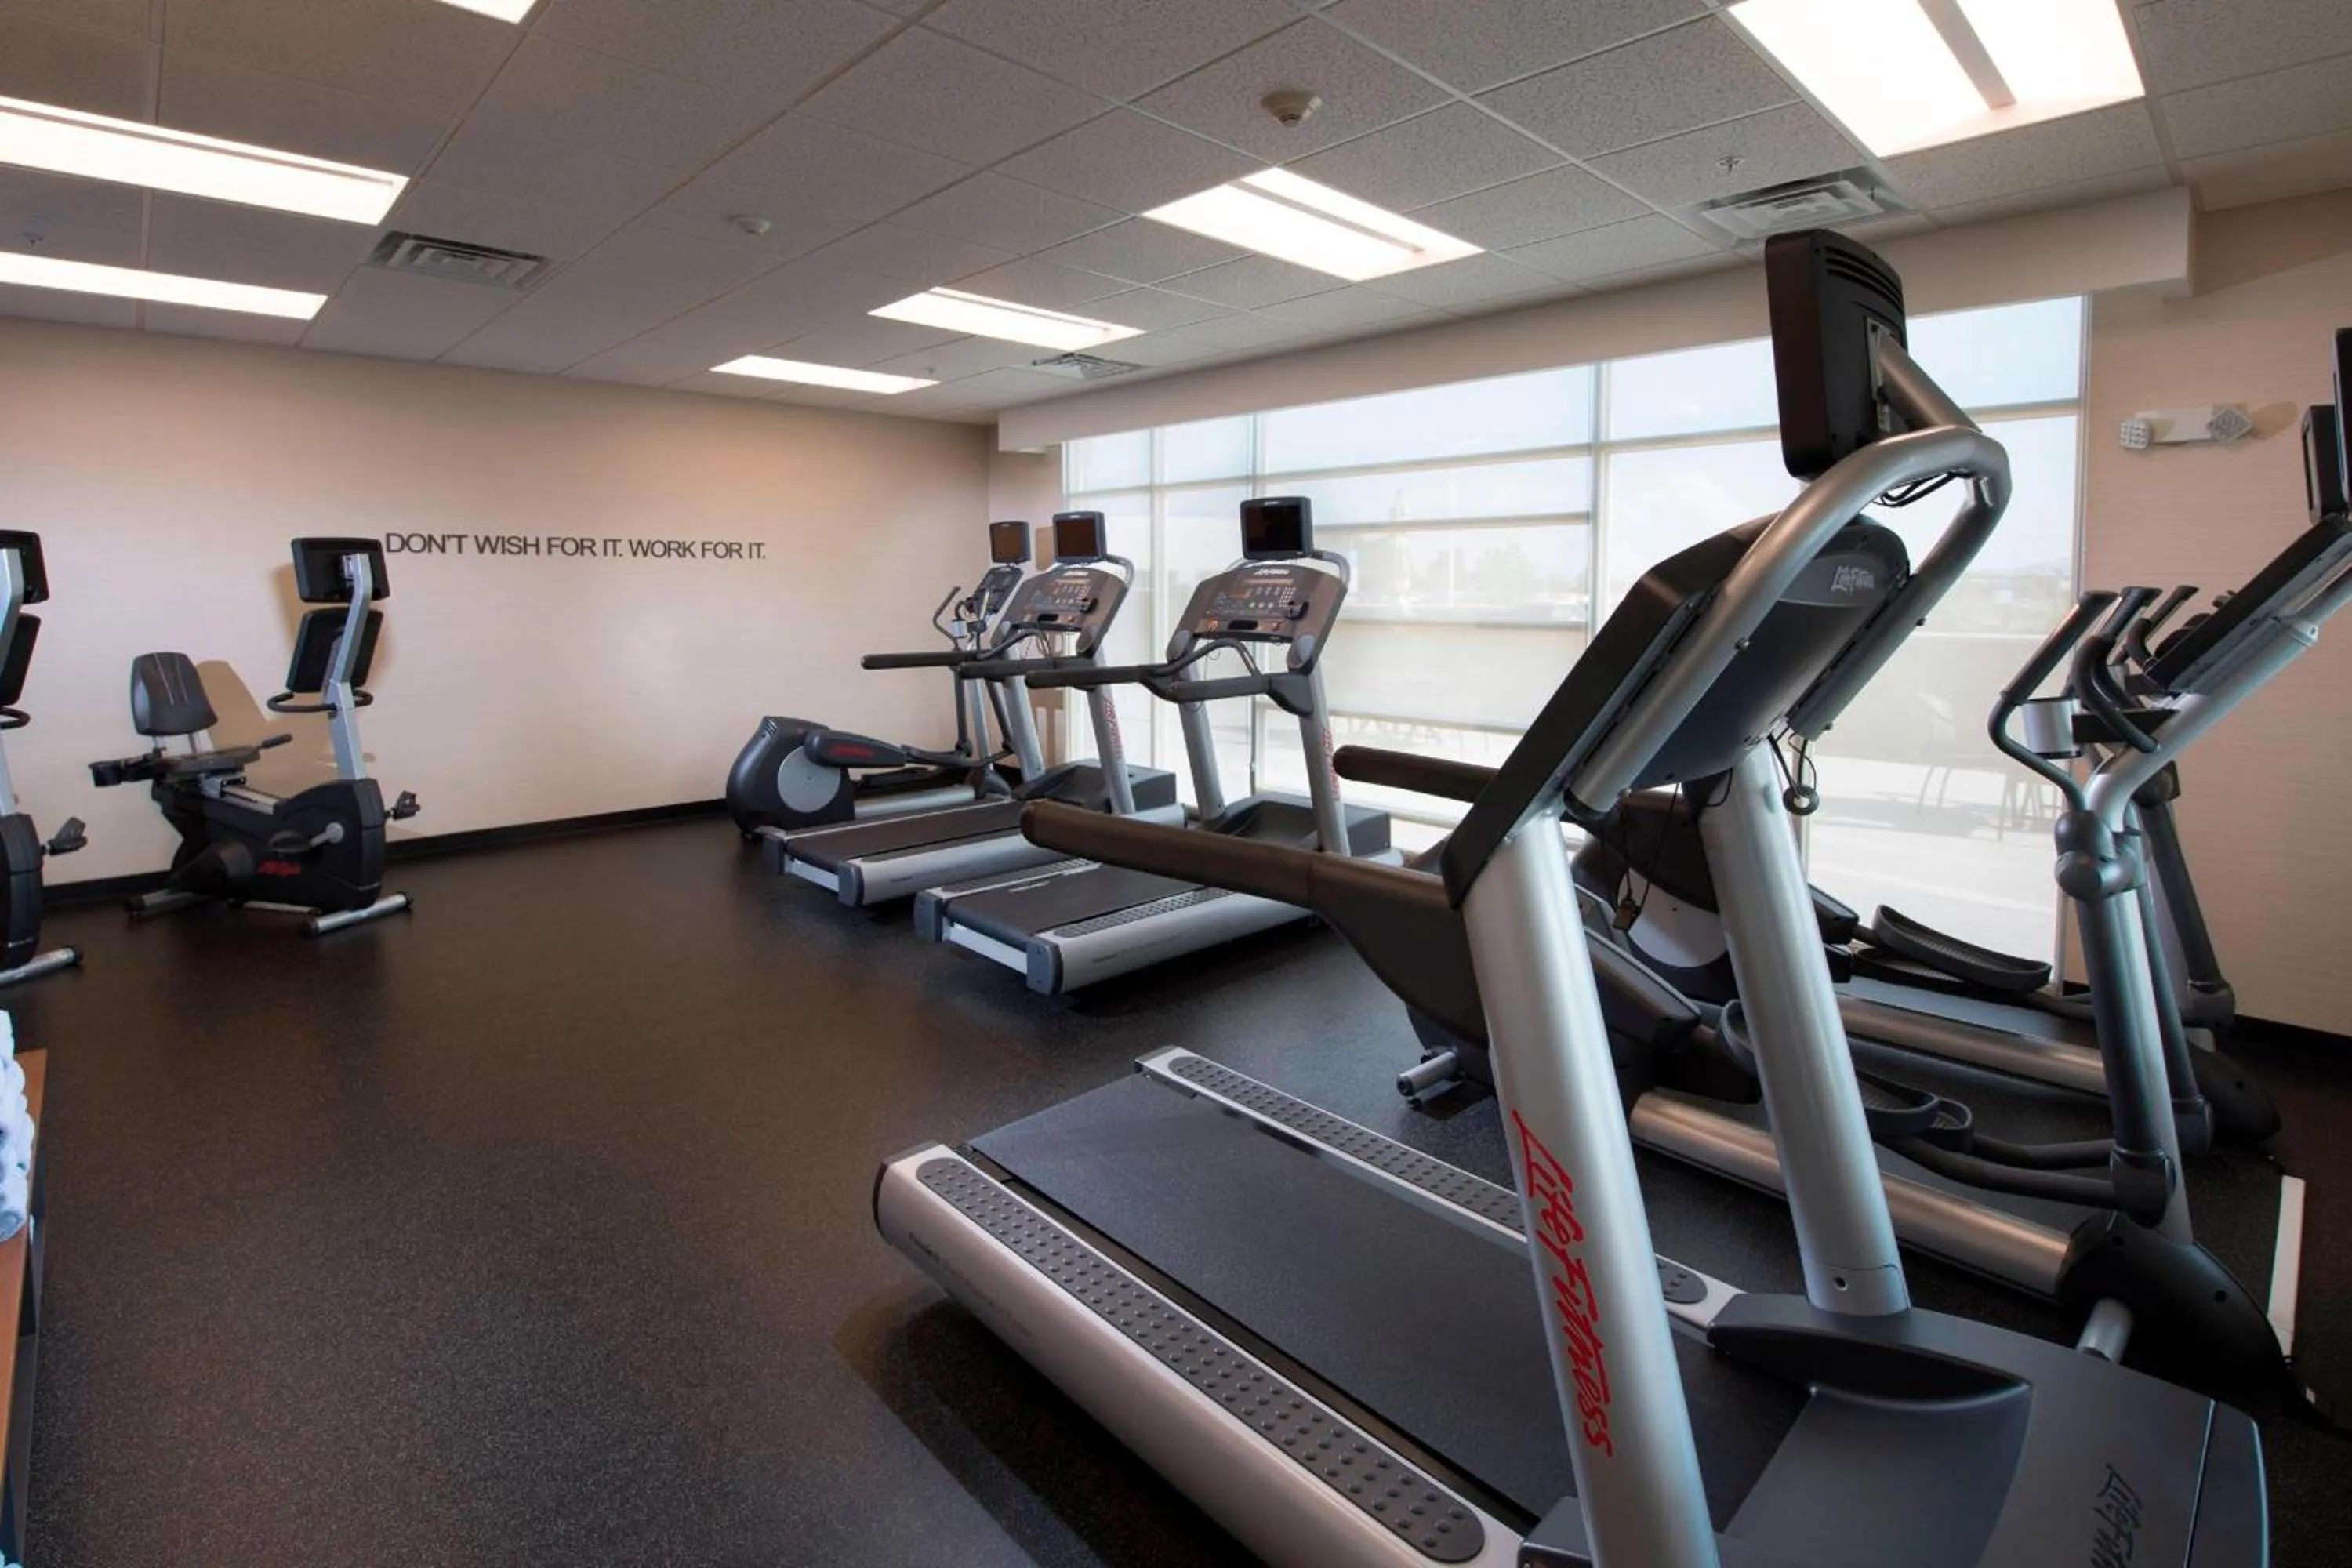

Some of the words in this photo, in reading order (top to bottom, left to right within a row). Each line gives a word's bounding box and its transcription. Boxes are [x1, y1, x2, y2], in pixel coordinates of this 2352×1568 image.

[386, 532, 468, 554] DON'T
[474, 535, 540, 555] WISH
[547, 537, 597, 557] FOR
[603, 539, 622, 557] IT.
[628, 539, 697, 558] WORK
[702, 541, 743, 559] FOR
[749, 543, 765, 559] IT.
